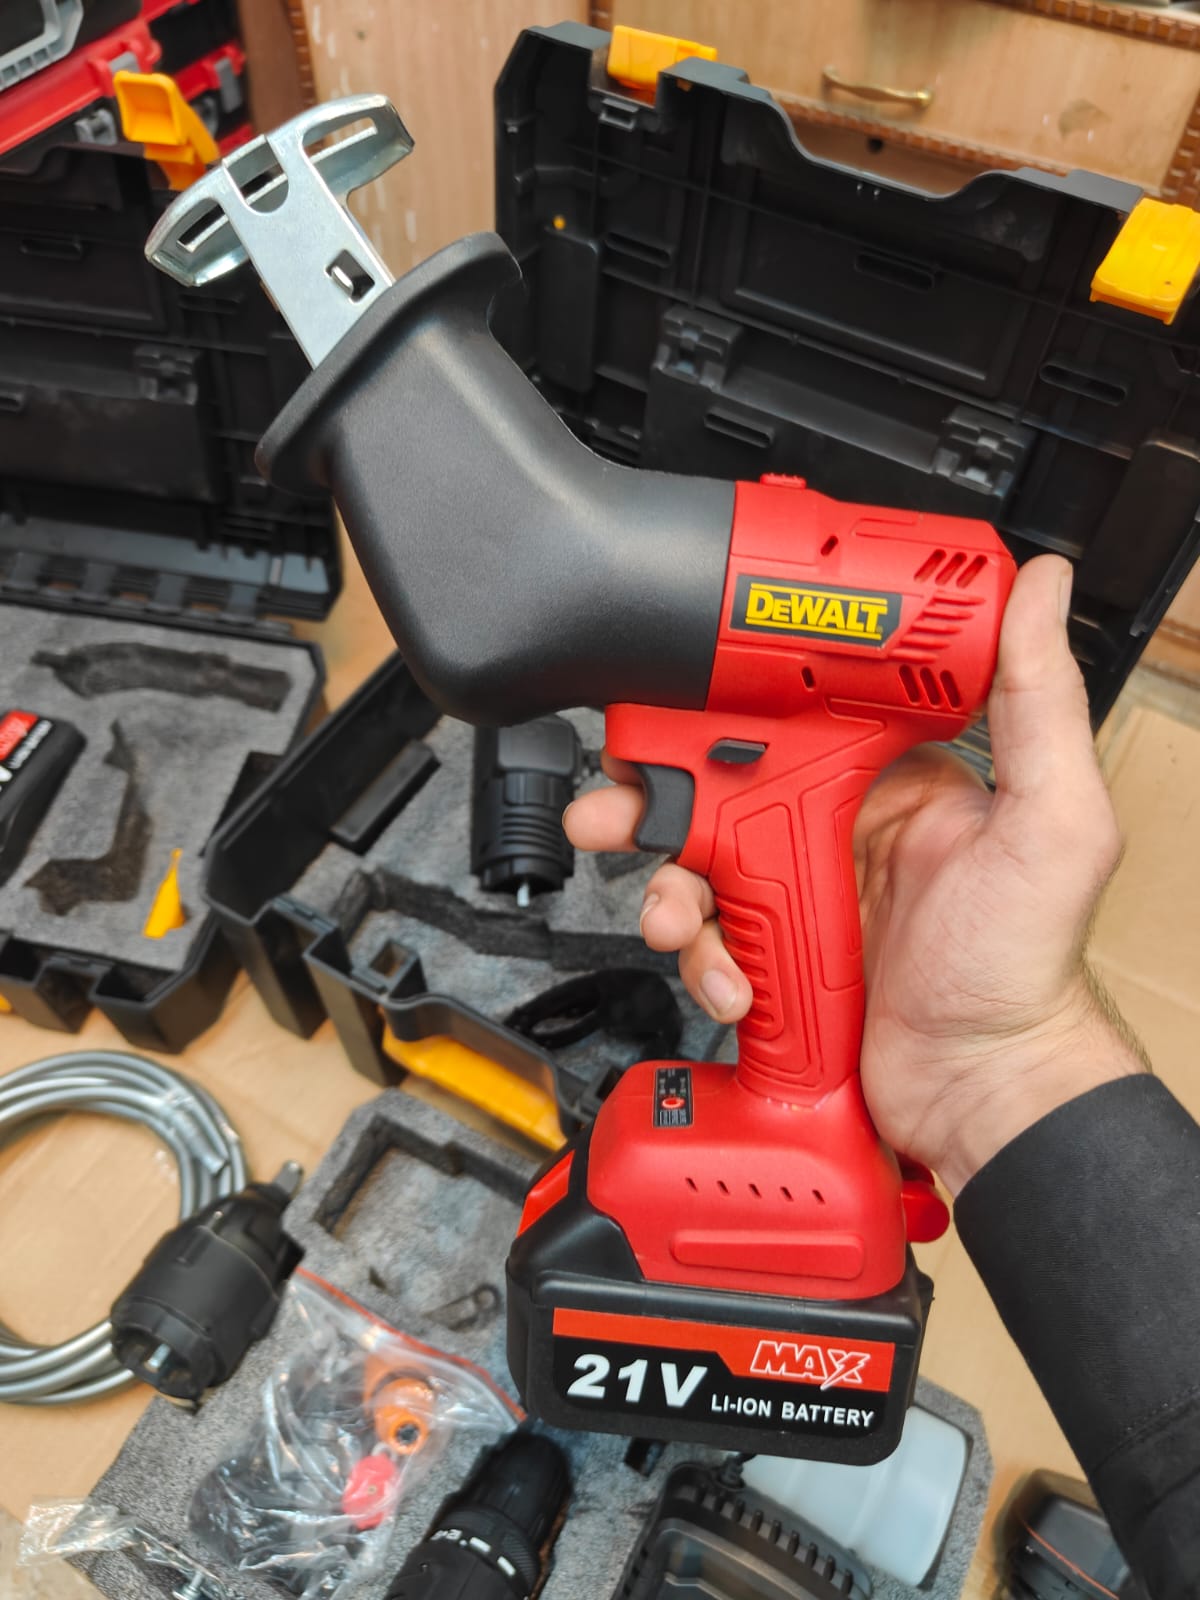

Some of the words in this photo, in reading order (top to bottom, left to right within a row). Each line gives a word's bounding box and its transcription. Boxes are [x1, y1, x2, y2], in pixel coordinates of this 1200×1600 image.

[567, 1353, 708, 1408] 21V
[751, 1340, 870, 1391] MAX
[711, 1393, 772, 1417] LI-ION
[781, 1401, 874, 1427] BATTERY
